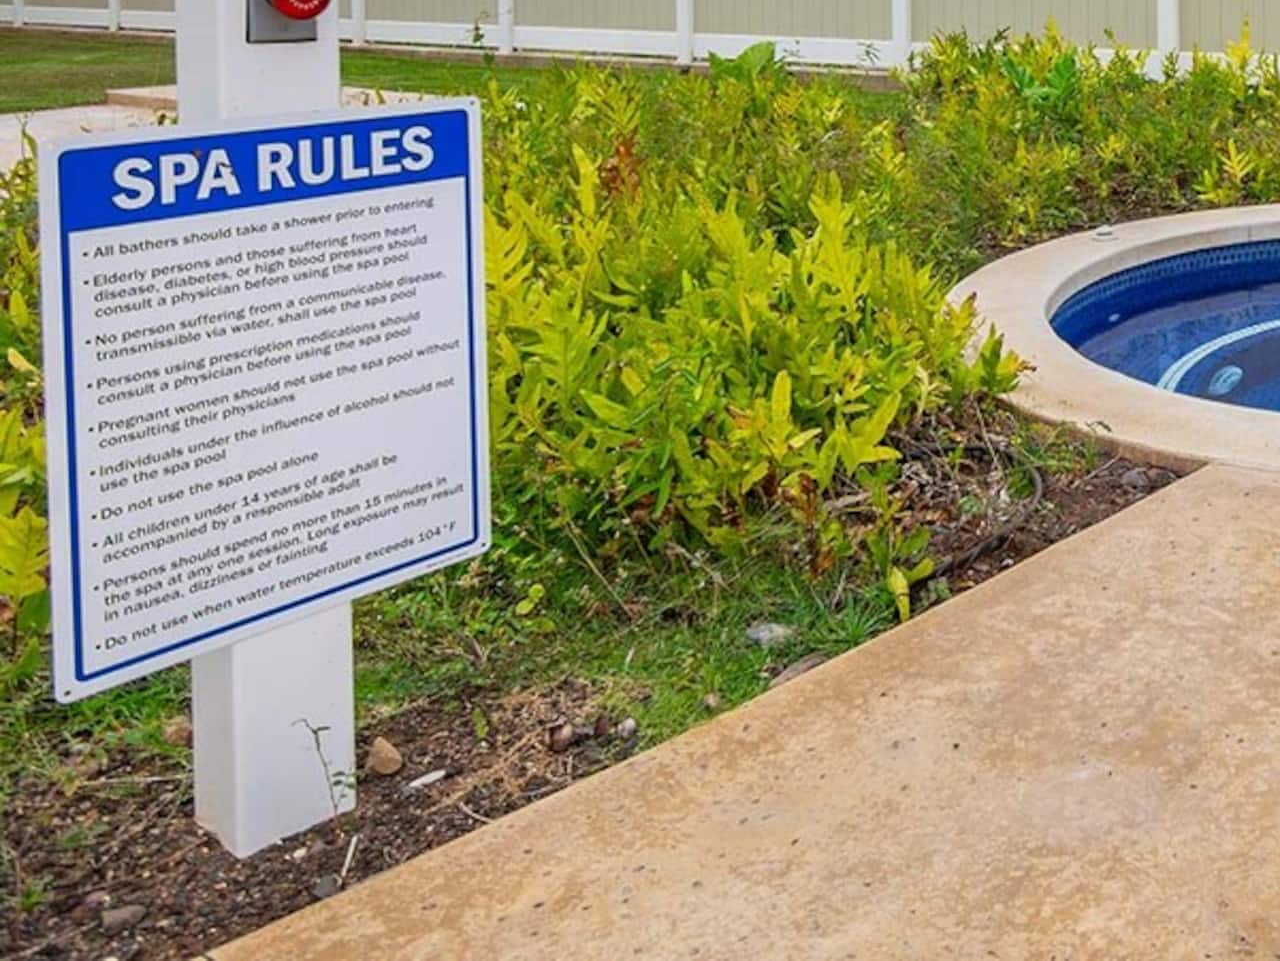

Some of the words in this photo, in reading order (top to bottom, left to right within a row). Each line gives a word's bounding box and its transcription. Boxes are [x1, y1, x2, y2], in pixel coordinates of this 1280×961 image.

[111, 149, 241, 210] SPA
[256, 125, 434, 192] RULES
[92, 268, 147, 288] Elderly
[151, 259, 212, 280] persons
[215, 251, 243, 267] and
[246, 246, 286, 262] those
[288, 235, 349, 254] suffering
[350, 230, 382, 244] from
[383, 223, 417, 238] heart
[93, 245, 114, 259] All
[118, 237, 179, 255] bathers
[182, 227, 232, 245] should
[235, 223, 268, 237] take
[271, 221, 281, 231] a
[283, 213, 332, 229] shower
[335, 208, 366, 224] prior
[368, 205, 382, 216] to
[383, 196, 435, 214] entering
[235, 266, 251, 278] or
[254, 260, 285, 275] high
[287, 252, 326, 269] blood
[328, 243, 385, 264] pressure
[387, 234, 428, 251] should
[94, 297, 153, 318] consult
[157, 296, 167, 307] a
[170, 283, 241, 307] physician
[244, 274, 290, 291] before
[292, 266, 330, 282] using
[332, 262, 354, 275] the
[356, 258, 380, 270] spa
[382, 251, 409, 267] pool
[95, 333, 118, 346] No
[121, 322, 176, 344] person
[179, 307, 246, 330] suffering
[248, 301, 283, 316] from
[285, 299, 295, 309] a
[297, 279, 395, 307] communicable
[95, 331, 202, 362] transmissible
[205, 327, 227, 339] via
[277, 308, 310, 325] shall
[313, 305, 338, 318] use
[340, 300, 361, 312] the
[364, 294, 388, 307] spa
[389, 286, 417, 304] pool
[96, 368, 161, 390] Persons
[164, 357, 206, 376] using
[208, 339, 294, 367] prescription
[296, 321, 377, 347] medications
[379, 310, 421, 328] should
[97, 382, 156, 405] consult
[159, 381, 169, 392] a
[173, 364, 243, 391] physician
[246, 354, 292, 372] before
[295, 344, 332, 361] using
[334, 339, 356, 352] the
[358, 334, 382, 347] spa
[384, 325, 412, 343] pool
[97, 407, 171, 434] Pregnant
[174, 394, 229, 415] women
[233, 380, 281, 402] should
[283, 375, 306, 389] not
[309, 370, 333, 384] use
[336, 364, 358, 377] the
[360, 358, 384, 371] spa
[386, 348, 414, 367] pool
[416, 339, 460, 357] without
[98, 420, 181, 450] consulting
[183, 411, 219, 428] their
[221, 393, 296, 421] physicians
[99, 446, 184, 477] Individuals
[187, 435, 231, 454] under
[233, 428, 258, 442] the
[261, 411, 324, 435] influence
[326, 404, 341, 418] of
[343, 392, 390, 414] alcohol
[392, 382, 433, 401] should
[435, 376, 455, 390] not
[99, 477, 129, 493] use
[132, 469, 159, 484] the
[162, 461, 191, 476] spa
[193, 448, 227, 470] pool
[100, 506, 124, 520] Do
[127, 496, 153, 513] not
[157, 489, 185, 505] use
[188, 481, 214, 496] the
[217, 473, 244, 488] spa
[247, 461, 278, 482] pool
[281, 452, 319, 470] alone
[102, 532, 124, 548] All
[127, 514, 191, 540] children
[193, 500, 237, 521] under
[242, 492, 260, 508] 14
[263, 482, 301, 503] years
[303, 475, 318, 489] of
[321, 469, 346, 484] age
[348, 457, 379, 476] shall
[381, 454, 398, 467] be
[102, 522, 208, 564] accompanied
[211, 518, 230, 531] by
[232, 514, 242, 525] a
[245, 489, 325, 520] responsible
[327, 478, 361, 496] adult
[103, 564, 167, 592] Persons
[170, 545, 221, 571] should
[223, 530, 268, 554] spend
[270, 526, 289, 539] no
[291, 514, 328, 532] more
[330, 503, 361, 520] than
[365, 495, 382, 510] 15
[383, 481, 434, 503] minutes
[436, 476, 447, 487] in
[104, 590, 131, 607] the
[135, 580, 163, 597] spa
[167, 572, 183, 587] at
[187, 564, 214, 581] any
[216, 554, 245, 570] one
[307, 522, 341, 542] Long
[342, 505, 400, 530] exposure
[402, 496, 428, 511] may
[430, 483, 464, 501] result
[104, 609, 120, 622] in
[188, 566, 255, 595] dizziness
[257, 559, 273, 572] or
[275, 540, 329, 566] fainting
[104, 635, 128, 650] Do
[131, 623, 157, 641] not
[161, 614, 189, 631] use
[192, 599, 233, 620] when
[236, 584, 276, 605] water
[278, 555, 362, 590] temperature
[364, 537, 415, 561] exceeds
